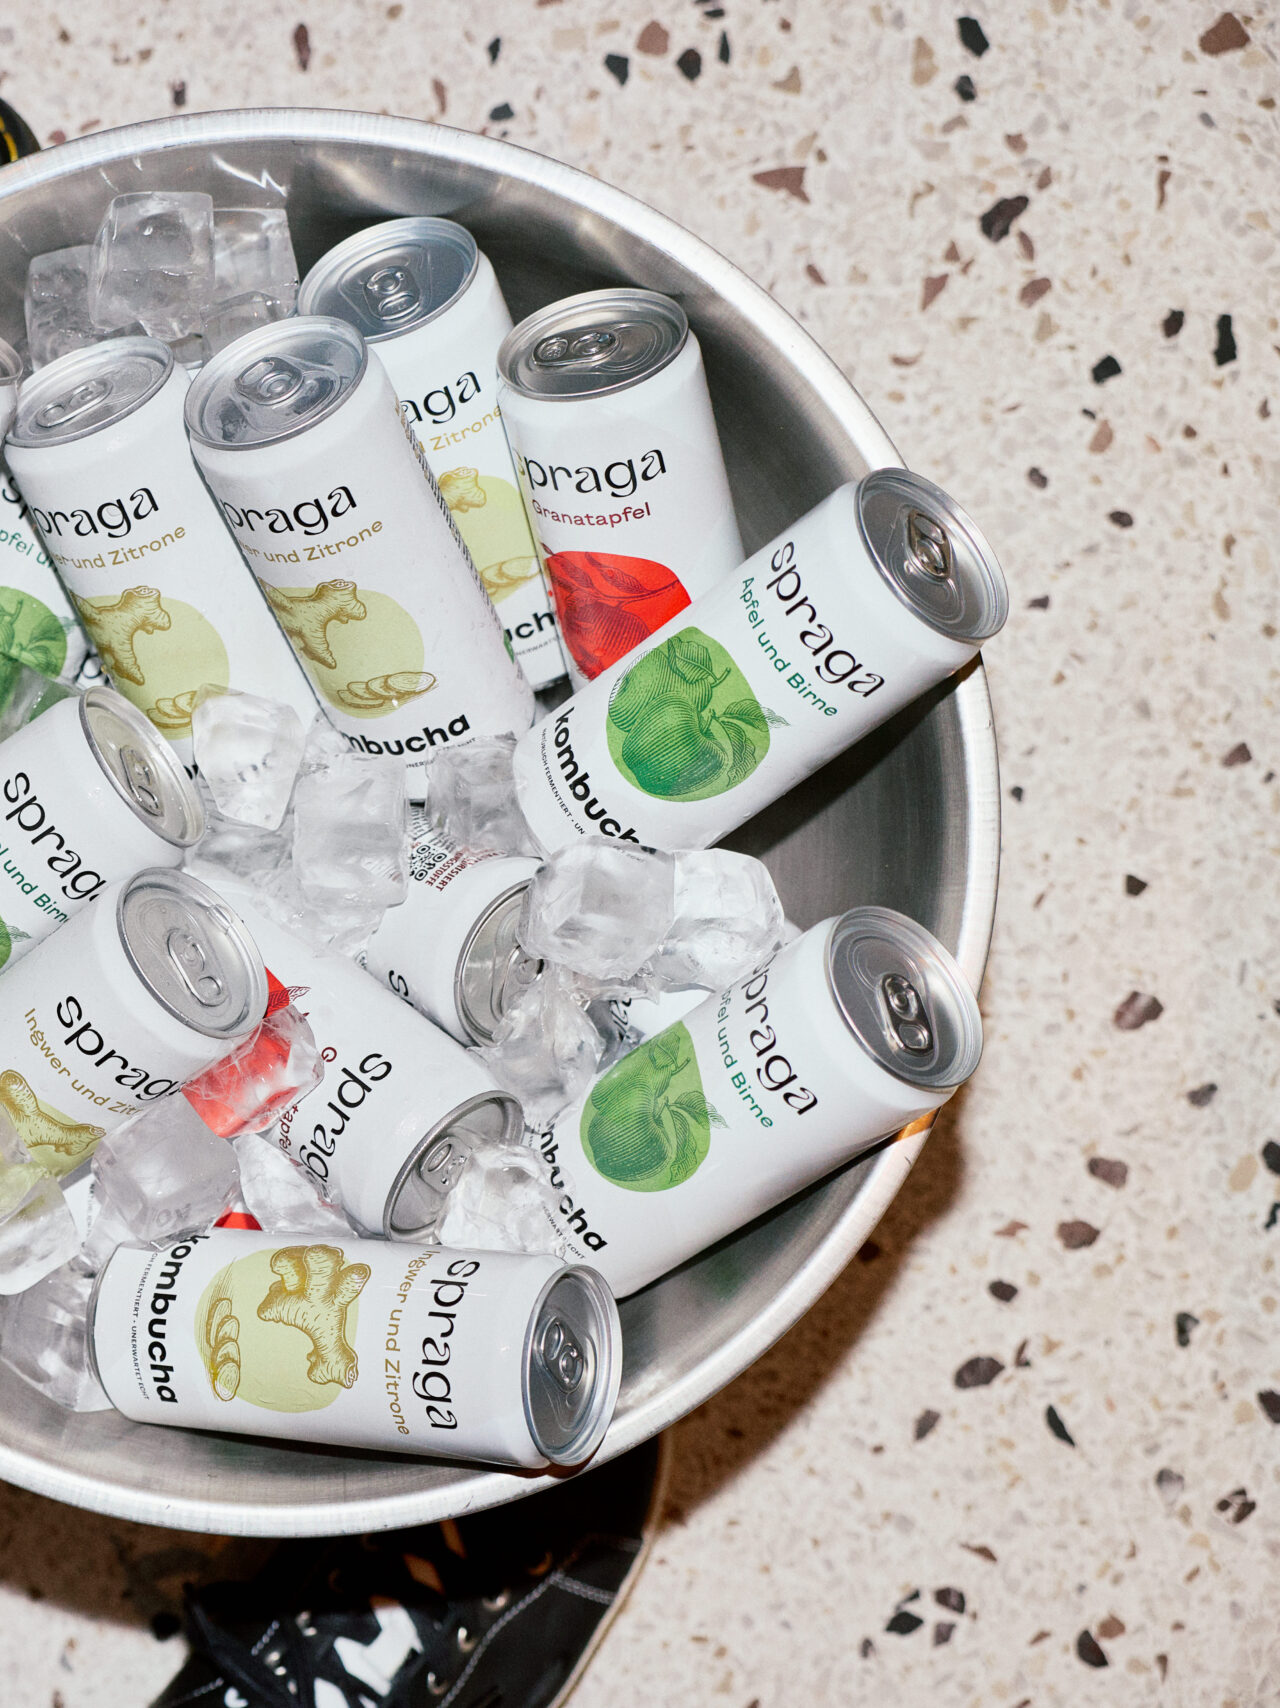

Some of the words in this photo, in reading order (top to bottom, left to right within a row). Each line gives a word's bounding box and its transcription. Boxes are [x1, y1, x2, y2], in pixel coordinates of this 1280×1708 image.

[531, 499, 651, 528] Granatapfel
[71, 553, 105, 569] und
[107, 526, 186, 566] Zitrone
[264, 550, 300, 563] und
[303, 520, 383, 562] Zitrone
[739, 576, 765, 629] Apfel
[758, 631, 791, 673] und
[786, 672, 838, 717] Birne
[766, 541, 885, 698] spraga
[543, 766, 572, 818] FERMENTIERT
[554, 706, 642, 846] kombuch
[3, 859, 38, 895] und
[24, 1007, 71, 1077] Ingwer
[71, 1079, 111, 1106] und
[717, 1027, 738, 1069] und
[731, 1071, 774, 1128] Birne
[132, 1263, 154, 1317] FERMENTIERT
[396, 1250, 441, 1304] Ingwer
[148, 1235, 211, 1403] kombucha
[385, 1309, 403, 1352] und
[412, 1259, 481, 1430] spraga
[131, 1325, 143, 1380] UNERWARTET
[138, 1379, 150, 1401] ECHT
[384, 1358, 410, 1435] Zitrone
